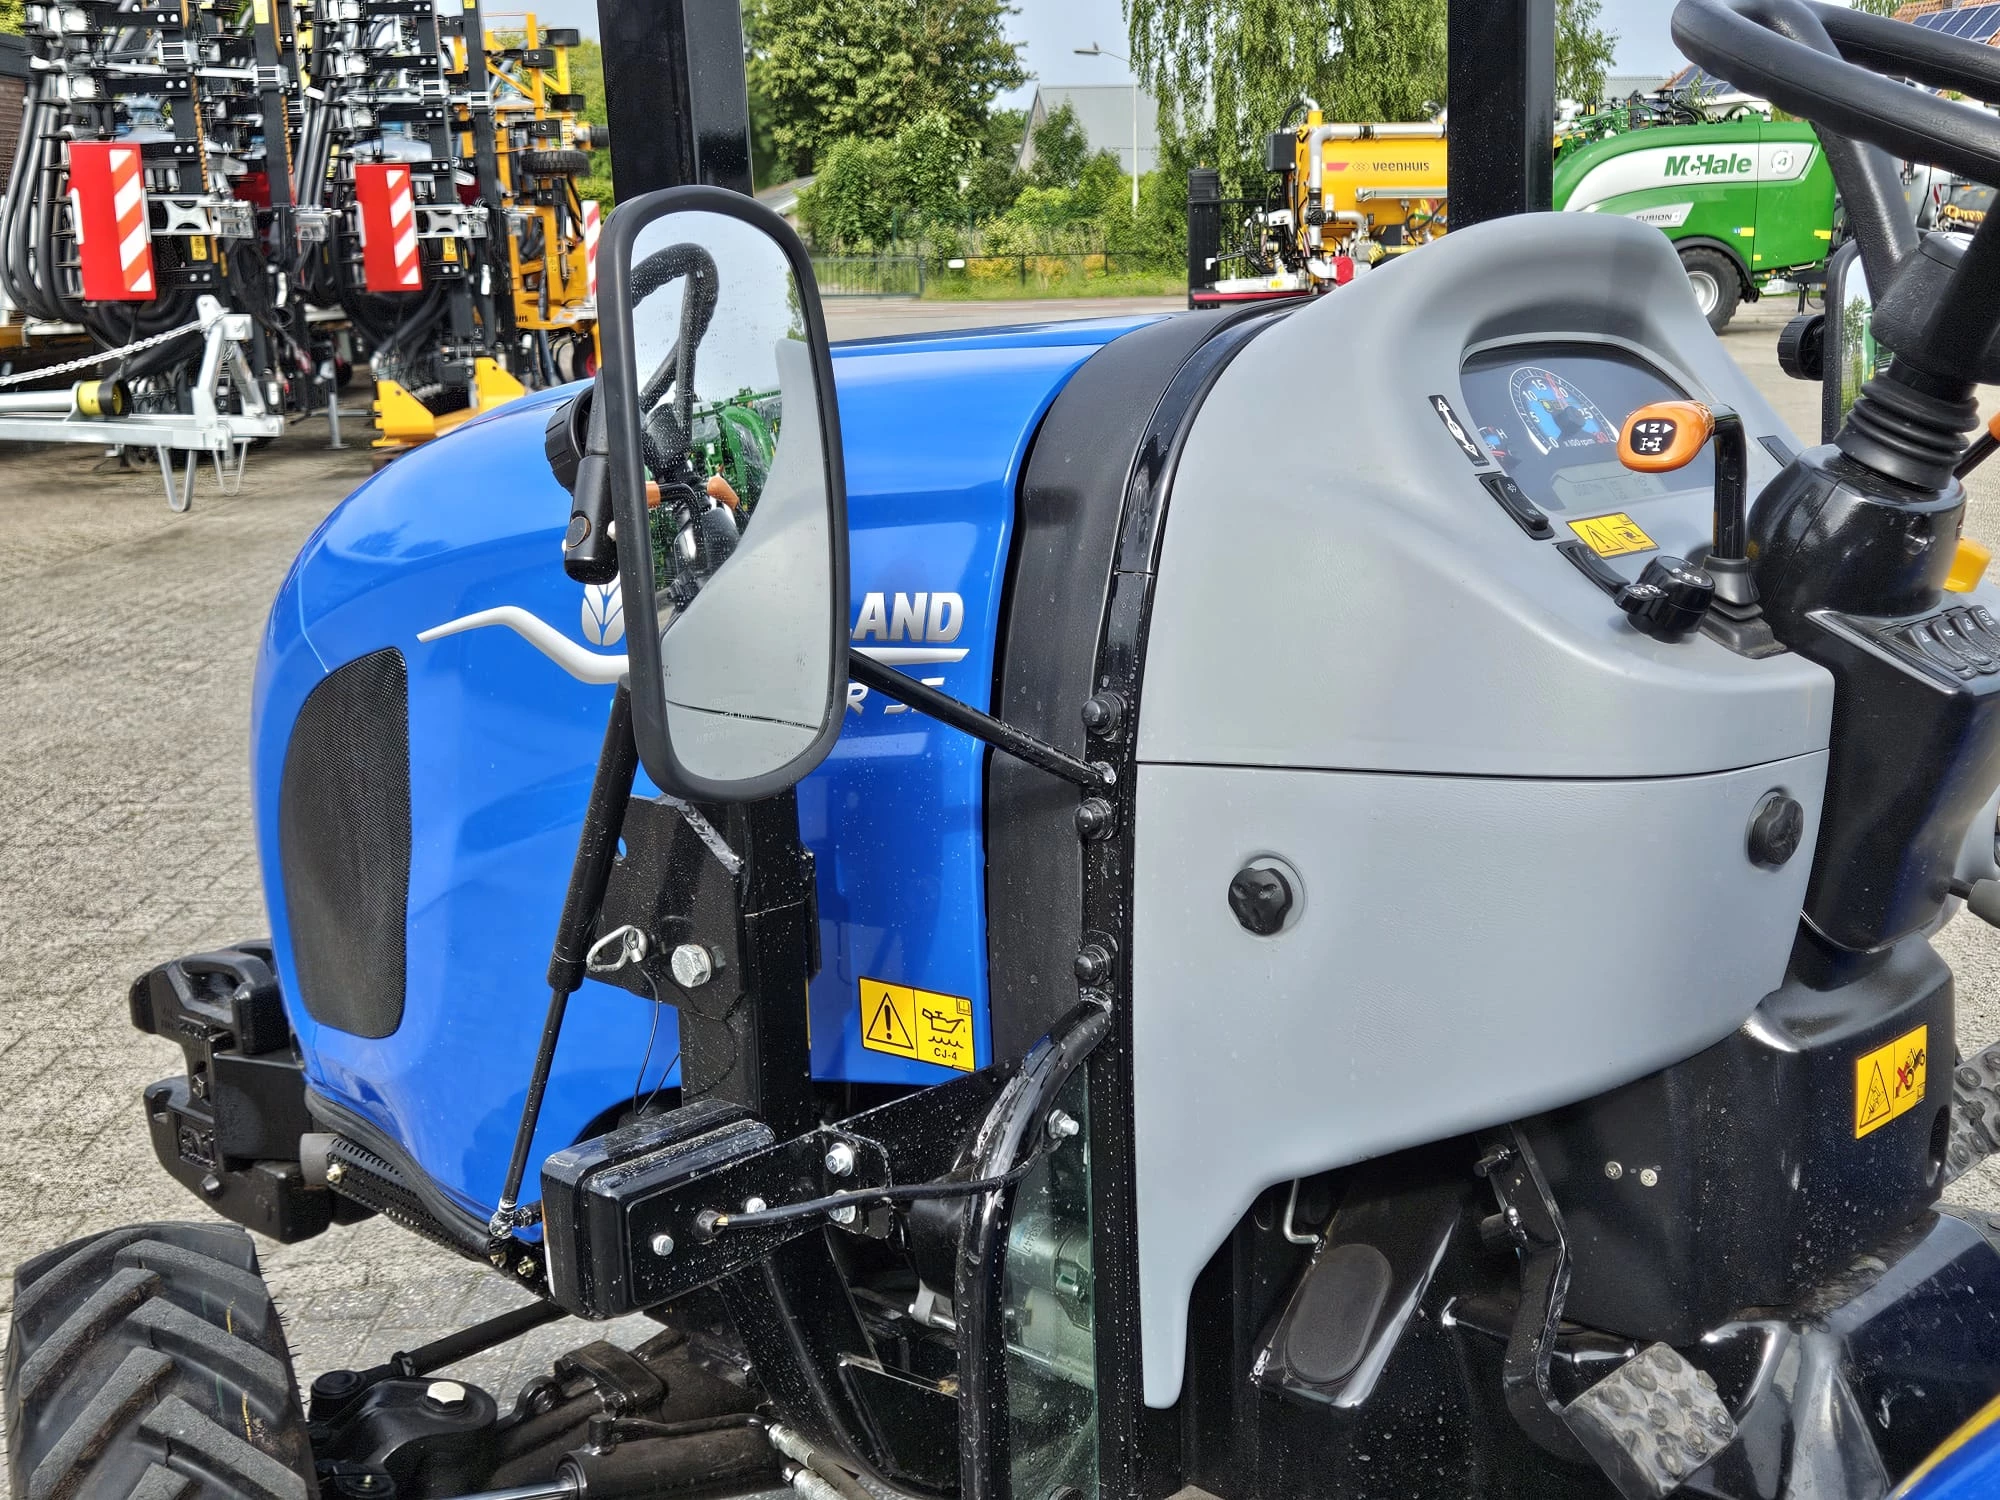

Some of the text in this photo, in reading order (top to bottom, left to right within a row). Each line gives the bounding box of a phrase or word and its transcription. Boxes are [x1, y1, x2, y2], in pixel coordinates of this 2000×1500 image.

[1664, 153, 1752, 177] McHale
[1531, 379, 1547, 391] 15
[1522, 390, 1538, 402] 10
[1529, 411, 1540, 423] 5
[1548, 436, 1560, 449] 0
[934, 1047, 957, 1061] CJ-4
